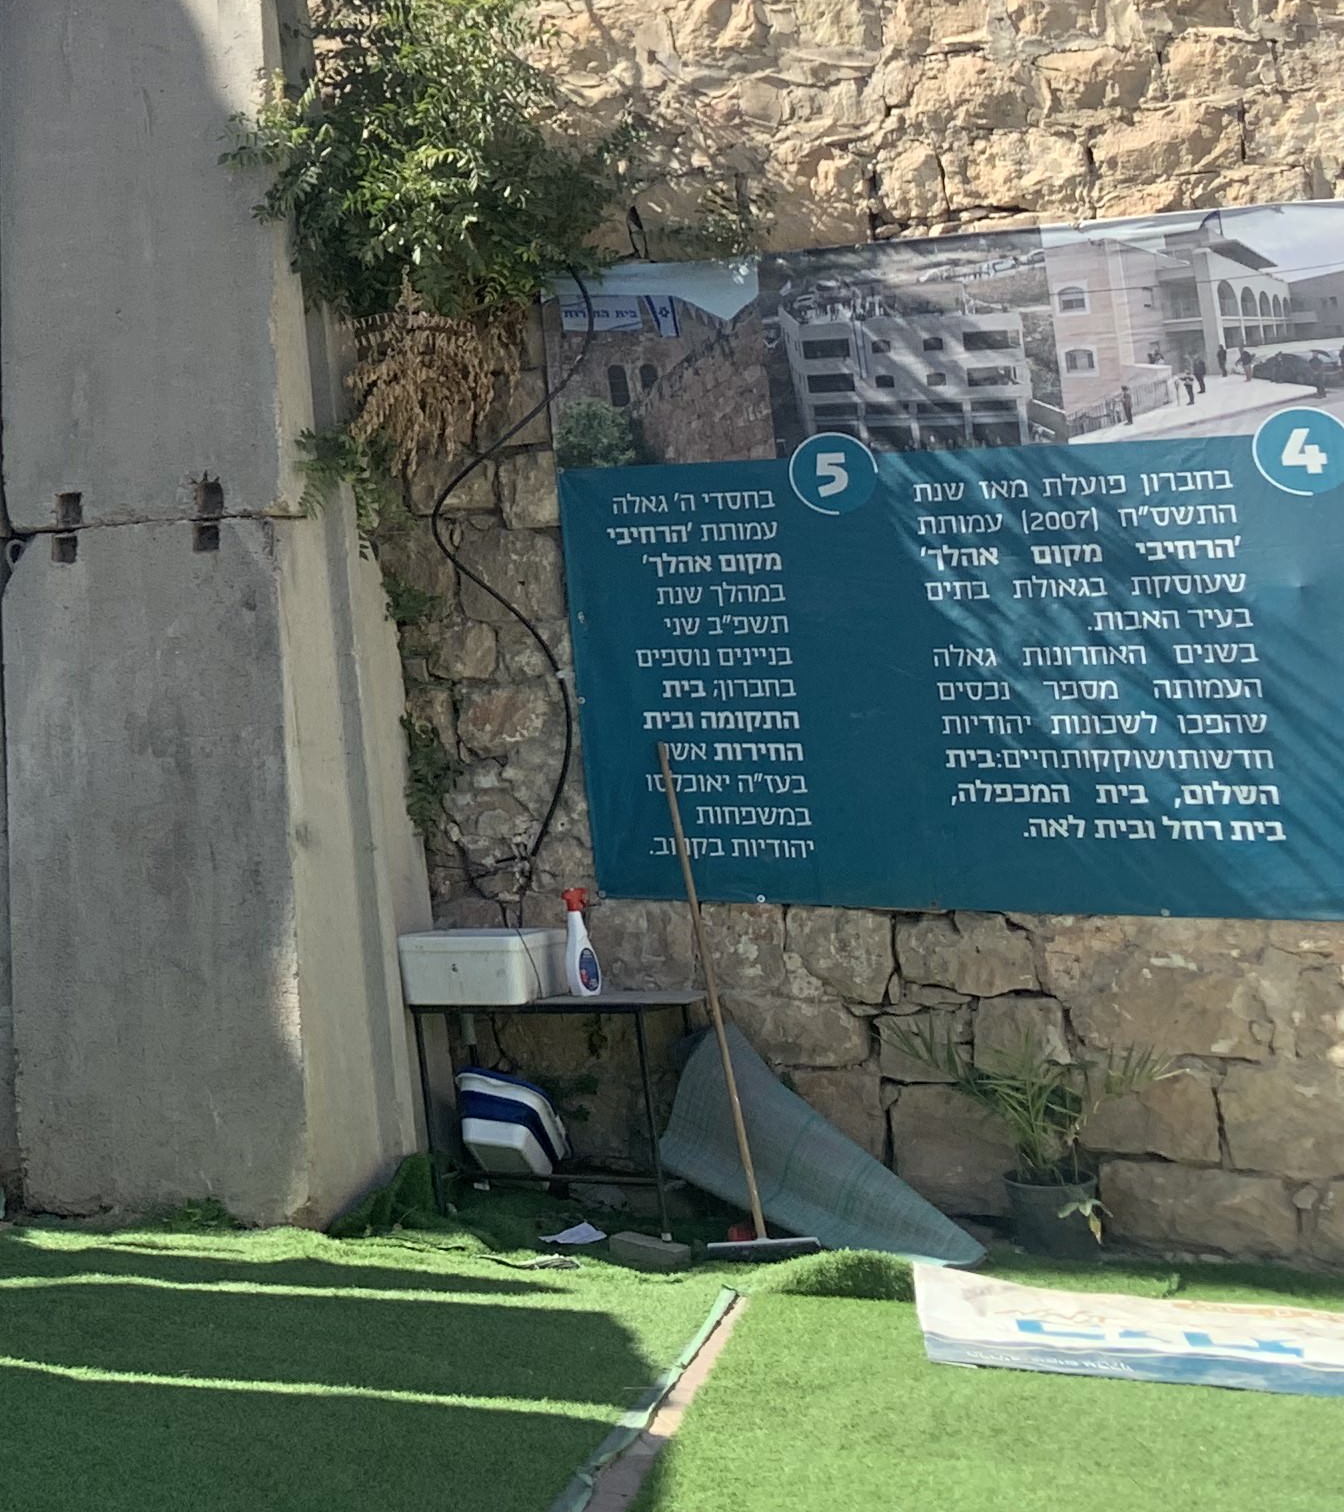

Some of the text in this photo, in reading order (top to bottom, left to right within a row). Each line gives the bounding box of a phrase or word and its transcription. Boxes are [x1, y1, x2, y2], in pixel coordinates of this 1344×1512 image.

[564, 309, 637, 318] בית החרות
[1281, 428, 1328, 473] 4
[816, 452, 848, 498] 5
[914, 469, 1233, 502] בחברון פועלת מאז שנת
[612, 494, 668, 514] גאלה
[702, 490, 776, 510] בחסדי
[700, 521, 777, 542] עמותת
[918, 513, 1003, 535] עמותת
[719, 553, 782, 574] מקום
[1032, 543, 1102, 567] מקום
[657, 582, 786, 606] במהלך שנת
[925, 572, 1246, 600] שעוסקת בגאולת בתים
[664, 617, 700, 636] שני
[1188, 607, 1253, 630] בעיר
[636, 648, 792, 666] בניינים נוספים
[934, 642, 1260, 668] בשנים האחרונות גאלה
[662, 680, 706, 698] בית
[937, 679, 1262, 701] העמותה מספר נכסים
[644, 711, 800, 732] התקומה ובית
[943, 712, 1266, 735] שהפכו לשכונות יהודיות
[714, 743, 804, 760] החירות
[1096, 784, 1148, 804] בית
[696, 806, 812, 826] במשפחות
[1095, 819, 1156, 839] ובית
[1162, 816, 1222, 840] רחל
[1231, 821, 1286, 841] בית
[732, 839, 814, 858] יהודיות
